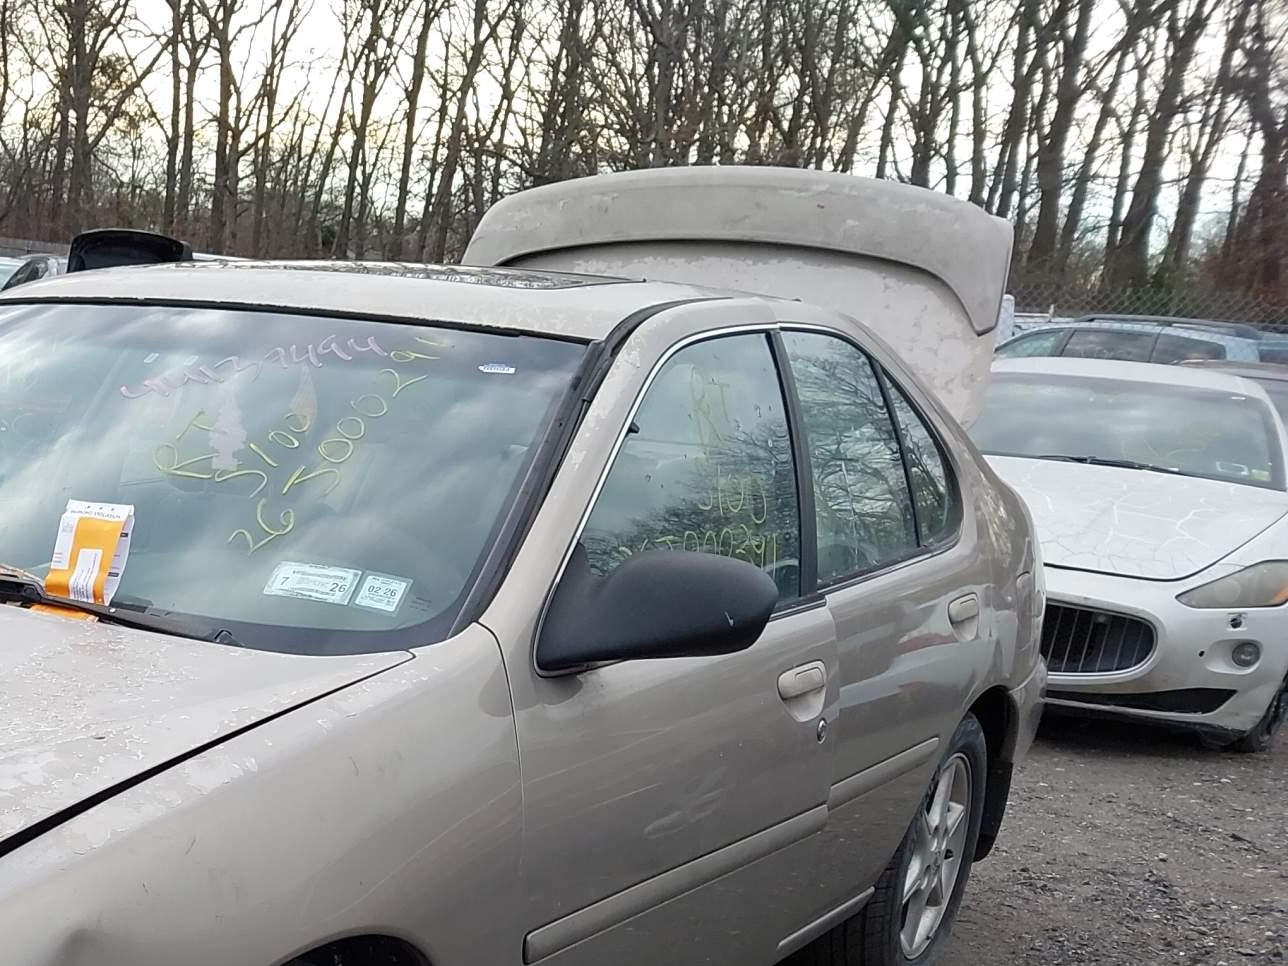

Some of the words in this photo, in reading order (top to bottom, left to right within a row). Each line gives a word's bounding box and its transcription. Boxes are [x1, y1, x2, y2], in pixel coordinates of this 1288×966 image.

[279, 576, 289, 586] 7
[328, 582, 348, 594] 26
[367, 584, 381, 594] 02
[383, 587, 397, 597] 26
